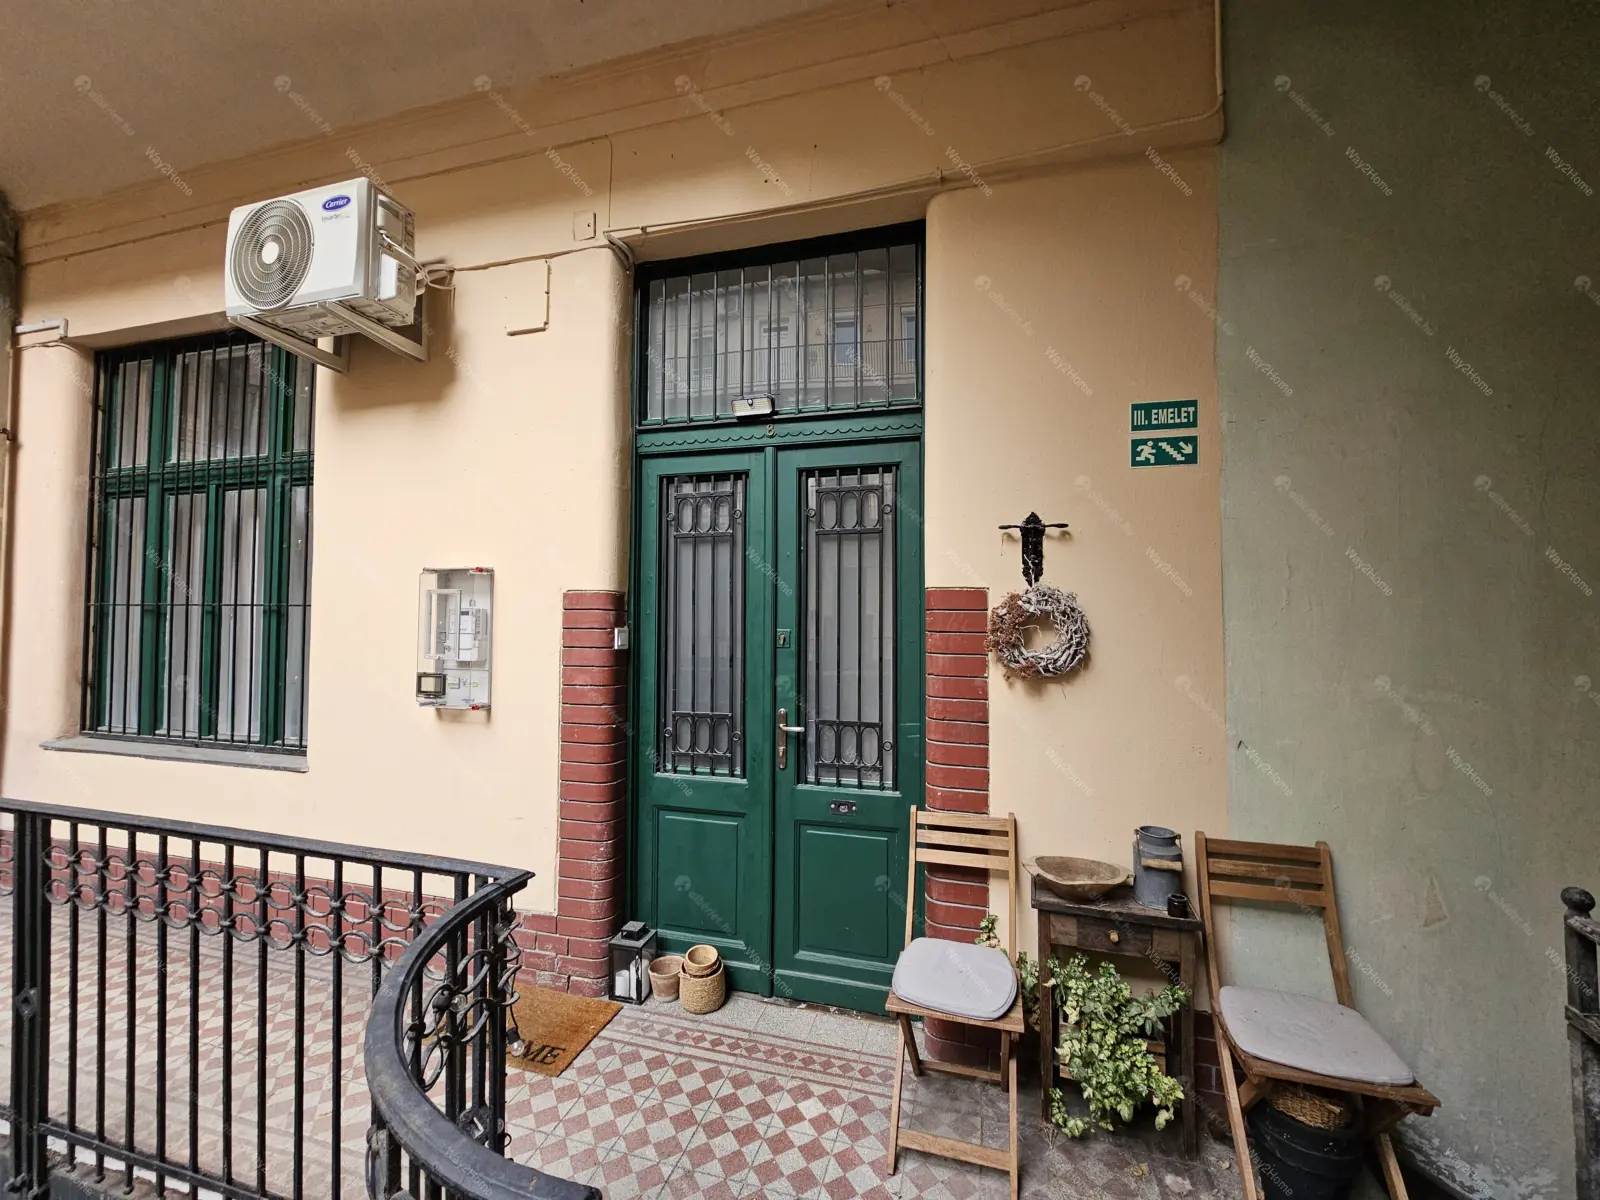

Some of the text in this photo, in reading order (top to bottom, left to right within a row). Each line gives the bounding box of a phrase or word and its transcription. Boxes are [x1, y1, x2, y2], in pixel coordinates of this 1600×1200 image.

[325, 198, 348, 209] Carrier
[1133, 407, 1195, 426] III. EMELET
[766, 424, 775, 435] 8
